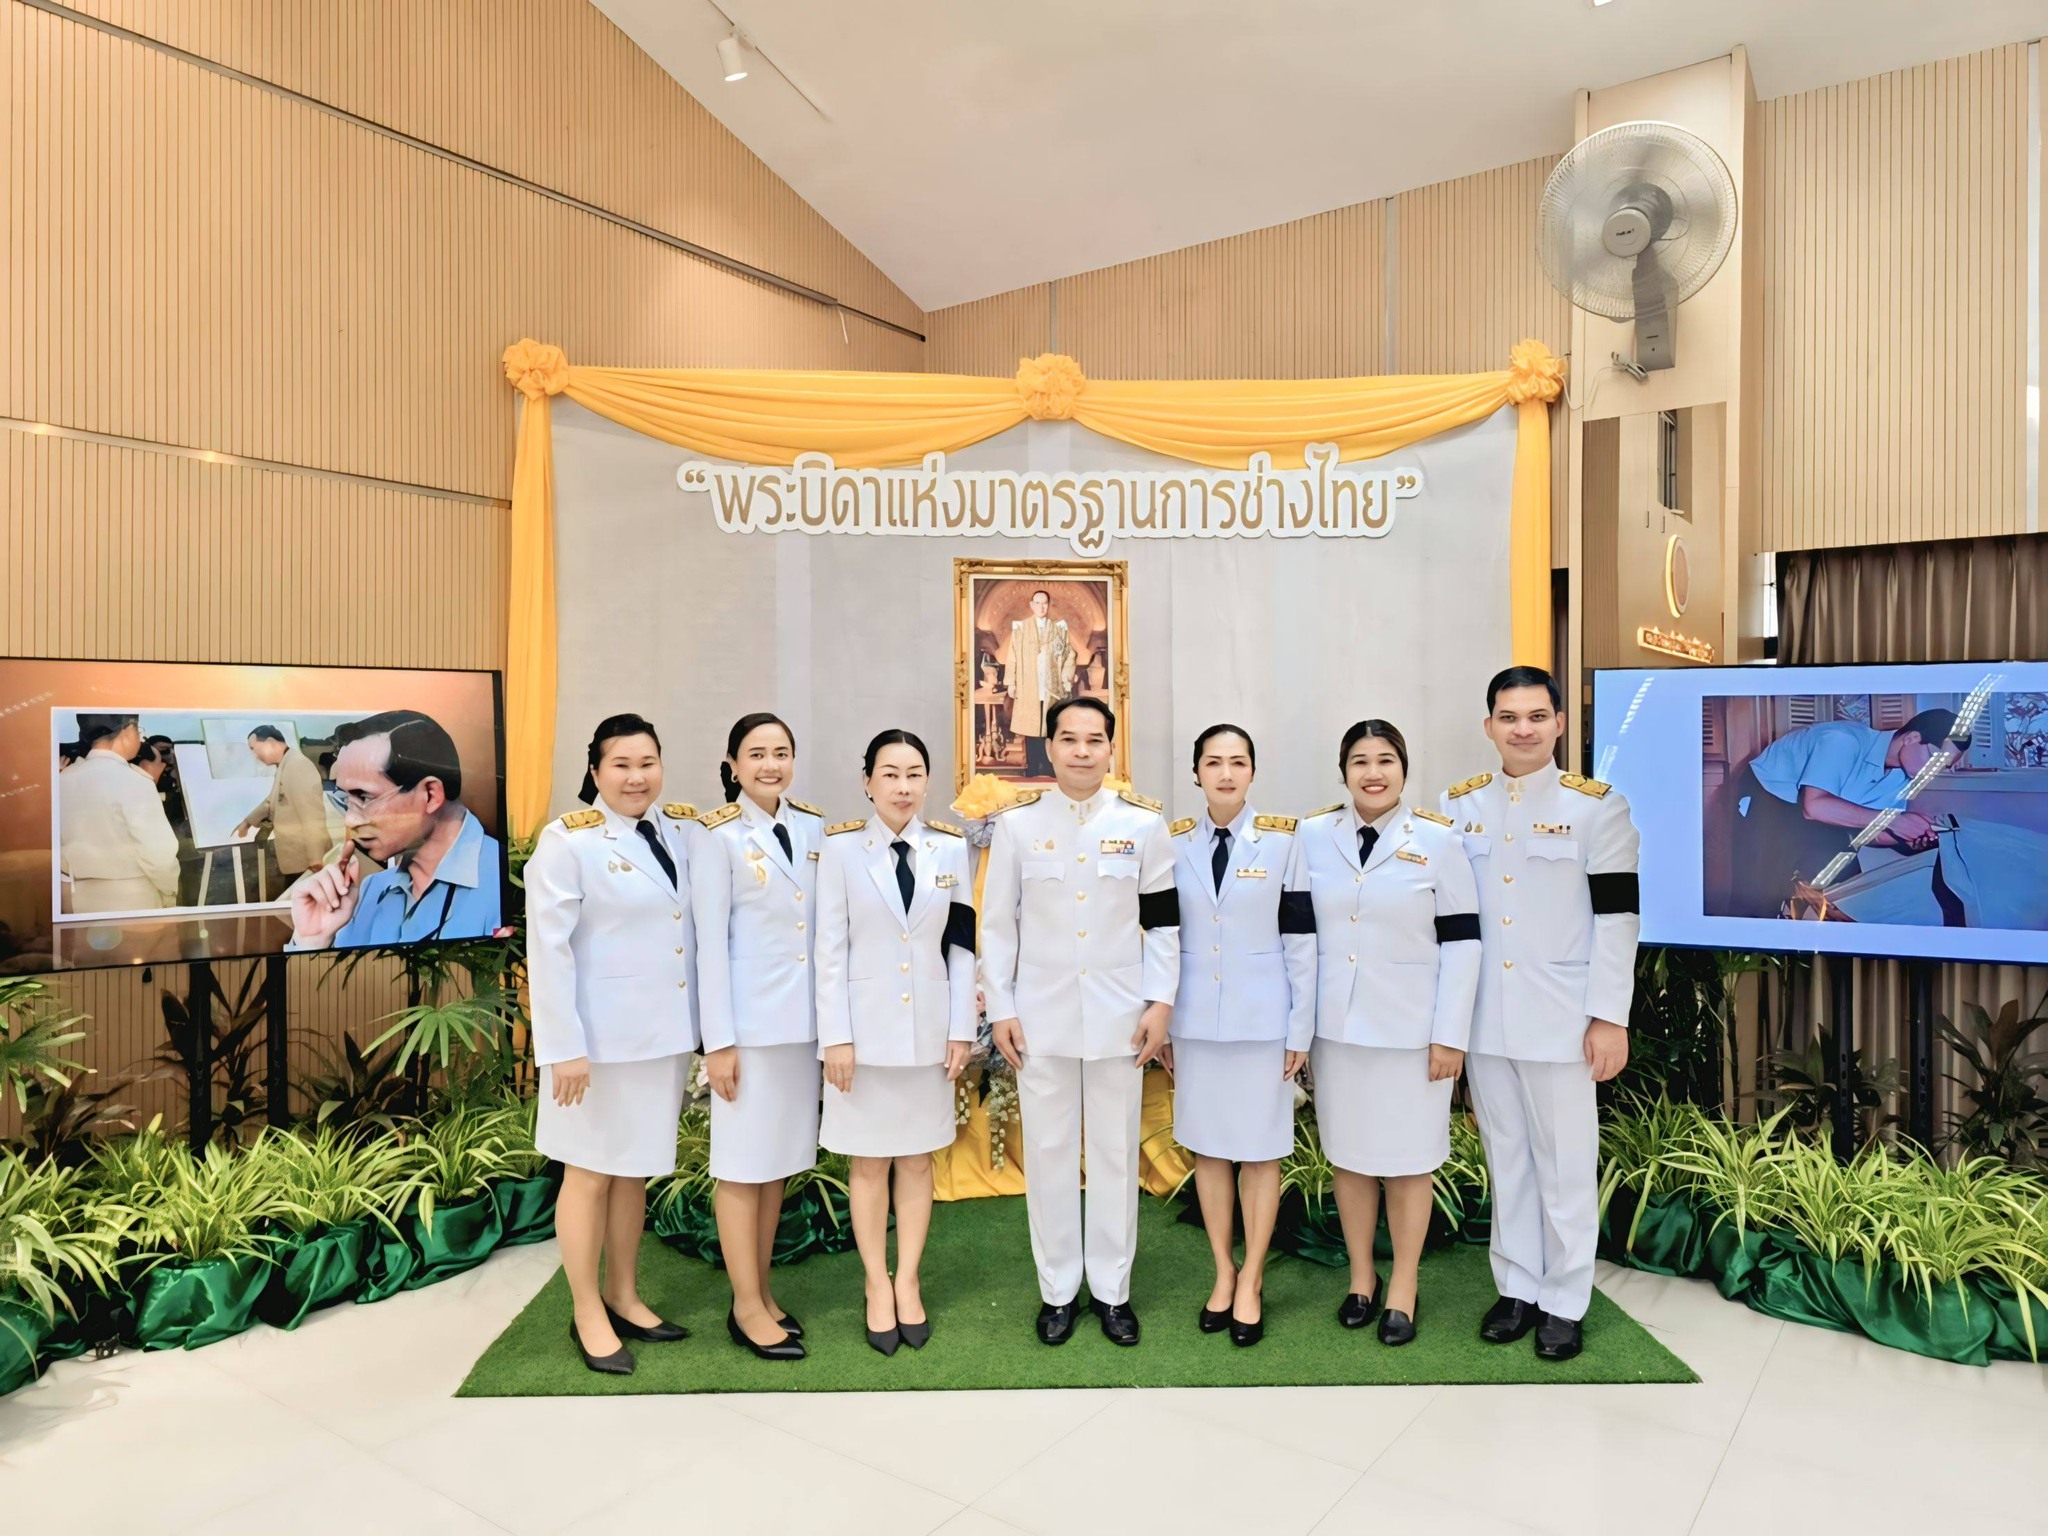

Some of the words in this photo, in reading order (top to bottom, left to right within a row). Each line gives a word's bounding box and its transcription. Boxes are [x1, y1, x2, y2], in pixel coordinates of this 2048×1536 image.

[684, 450, 1417, 549] “พระบิดาแห่งมาตรฐานการช่างไทย”
